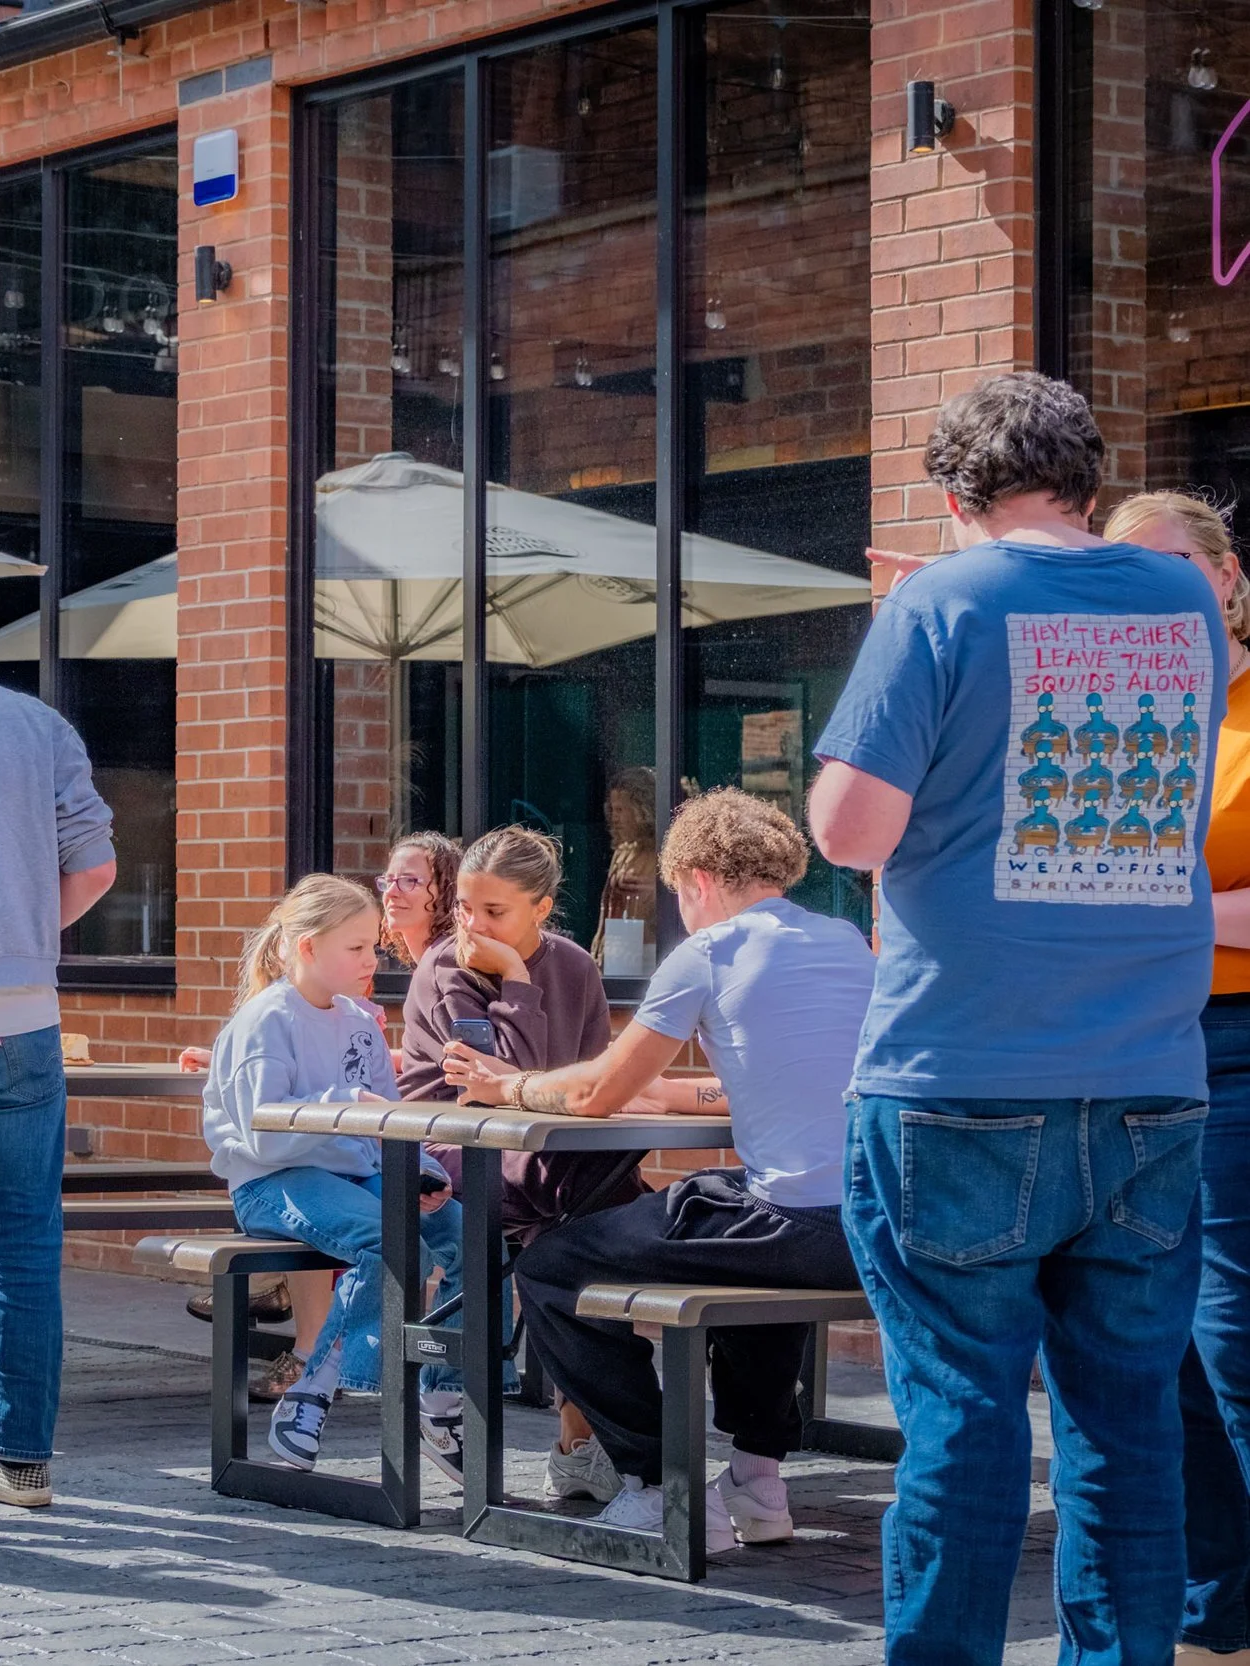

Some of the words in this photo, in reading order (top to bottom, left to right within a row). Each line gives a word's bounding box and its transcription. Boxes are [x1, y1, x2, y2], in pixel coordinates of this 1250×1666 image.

[1021, 617, 1070, 644] HEY!
[1073, 619, 1198, 648] TEACHER!
[1035, 647, 1113, 669] LEAVE
[1119, 651, 1189, 671] THEM
[1024, 672, 1115, 694] SQUIDS
[1126, 671, 1205, 692] ALONE!
